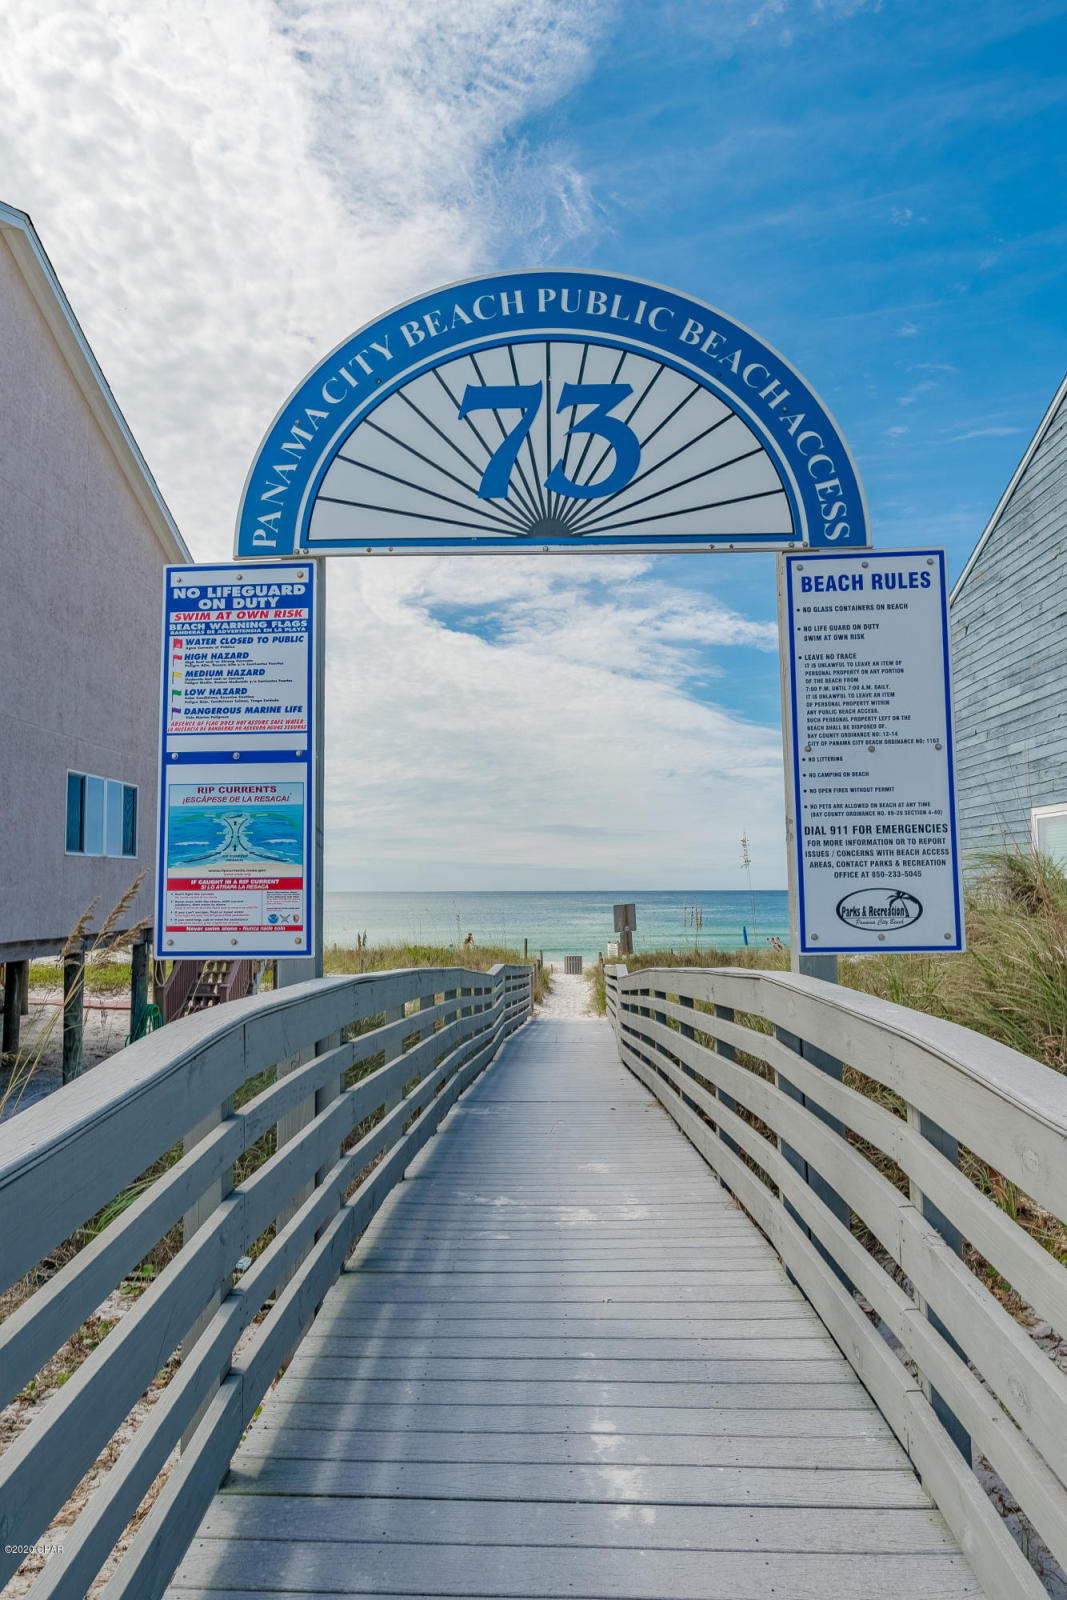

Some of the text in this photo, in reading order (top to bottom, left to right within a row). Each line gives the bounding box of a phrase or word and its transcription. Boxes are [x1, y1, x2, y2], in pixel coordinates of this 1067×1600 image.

[252, 288, 850, 548] PANAMA CITY BEACH PUBLIC BEACH ACCESS
[457, 379, 642, 500] 73
[801, 571, 932, 593] BEACH RULES
[173, 584, 306, 600] NO LIFEGUARD
[198, 597, 280, 610] ON DUTY
[174, 609, 304, 622] SWIM AT OWN RISK
[209, 621, 268, 630] WARNING
[272, 620, 308, 628] FLAGS
[272, 636, 304, 644] PUBLIC
[208, 688, 248, 696] HAZARD
[184, 707, 242, 715] DANGEROUS
[244, 706, 282, 714] MARINE
[198, 785, 277, 794] RIP CURRENTS
[804, 824, 948, 836] DIAL 911 FOR EMERGENCIES
[810, 861, 835, 869] AREAS,
[841, 906, 905, 917] Parks & Recreation
